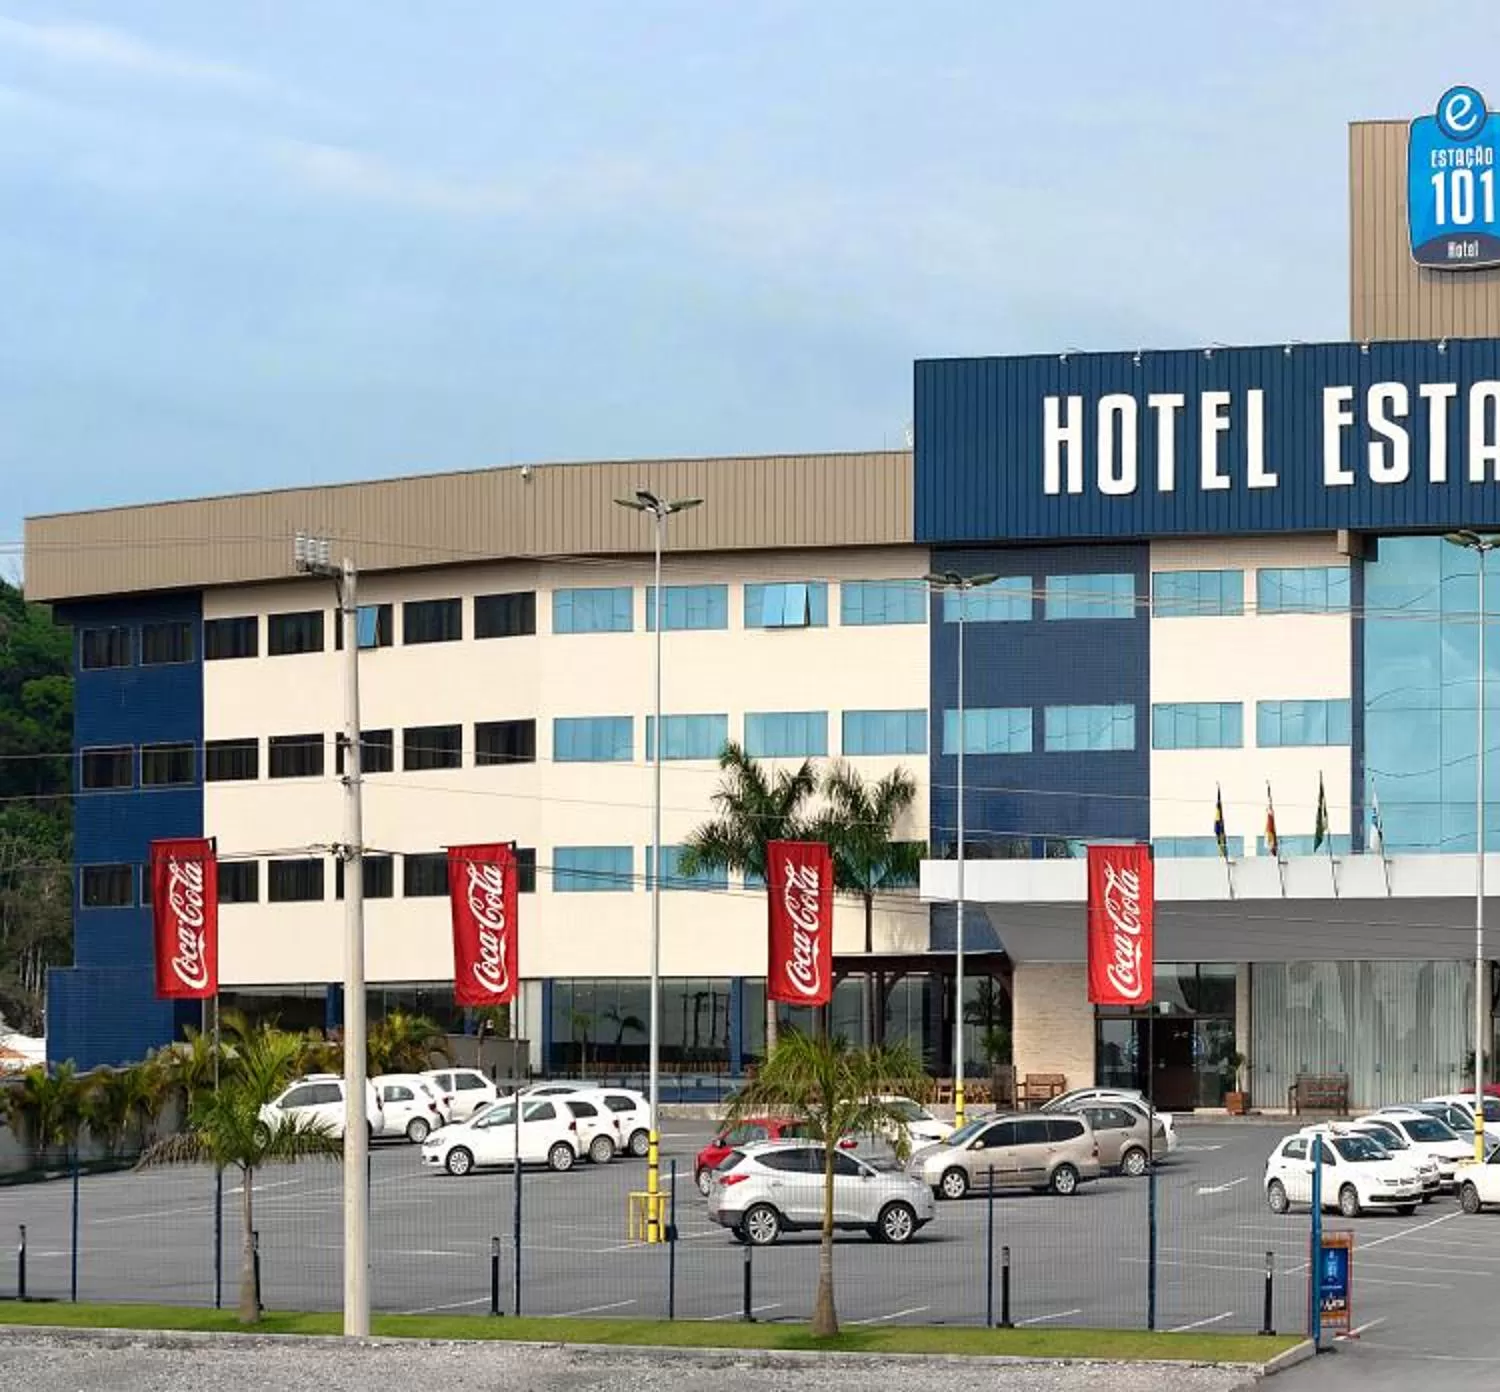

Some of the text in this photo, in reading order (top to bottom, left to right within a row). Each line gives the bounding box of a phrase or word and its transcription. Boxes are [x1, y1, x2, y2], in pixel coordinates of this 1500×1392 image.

[1431, 146, 1493, 169] ESTAÇÃO
[1431, 168, 1495, 225] 101
[1447, 241, 1479, 259] Hotel
[1044, 389, 1278, 495] HOTEL
